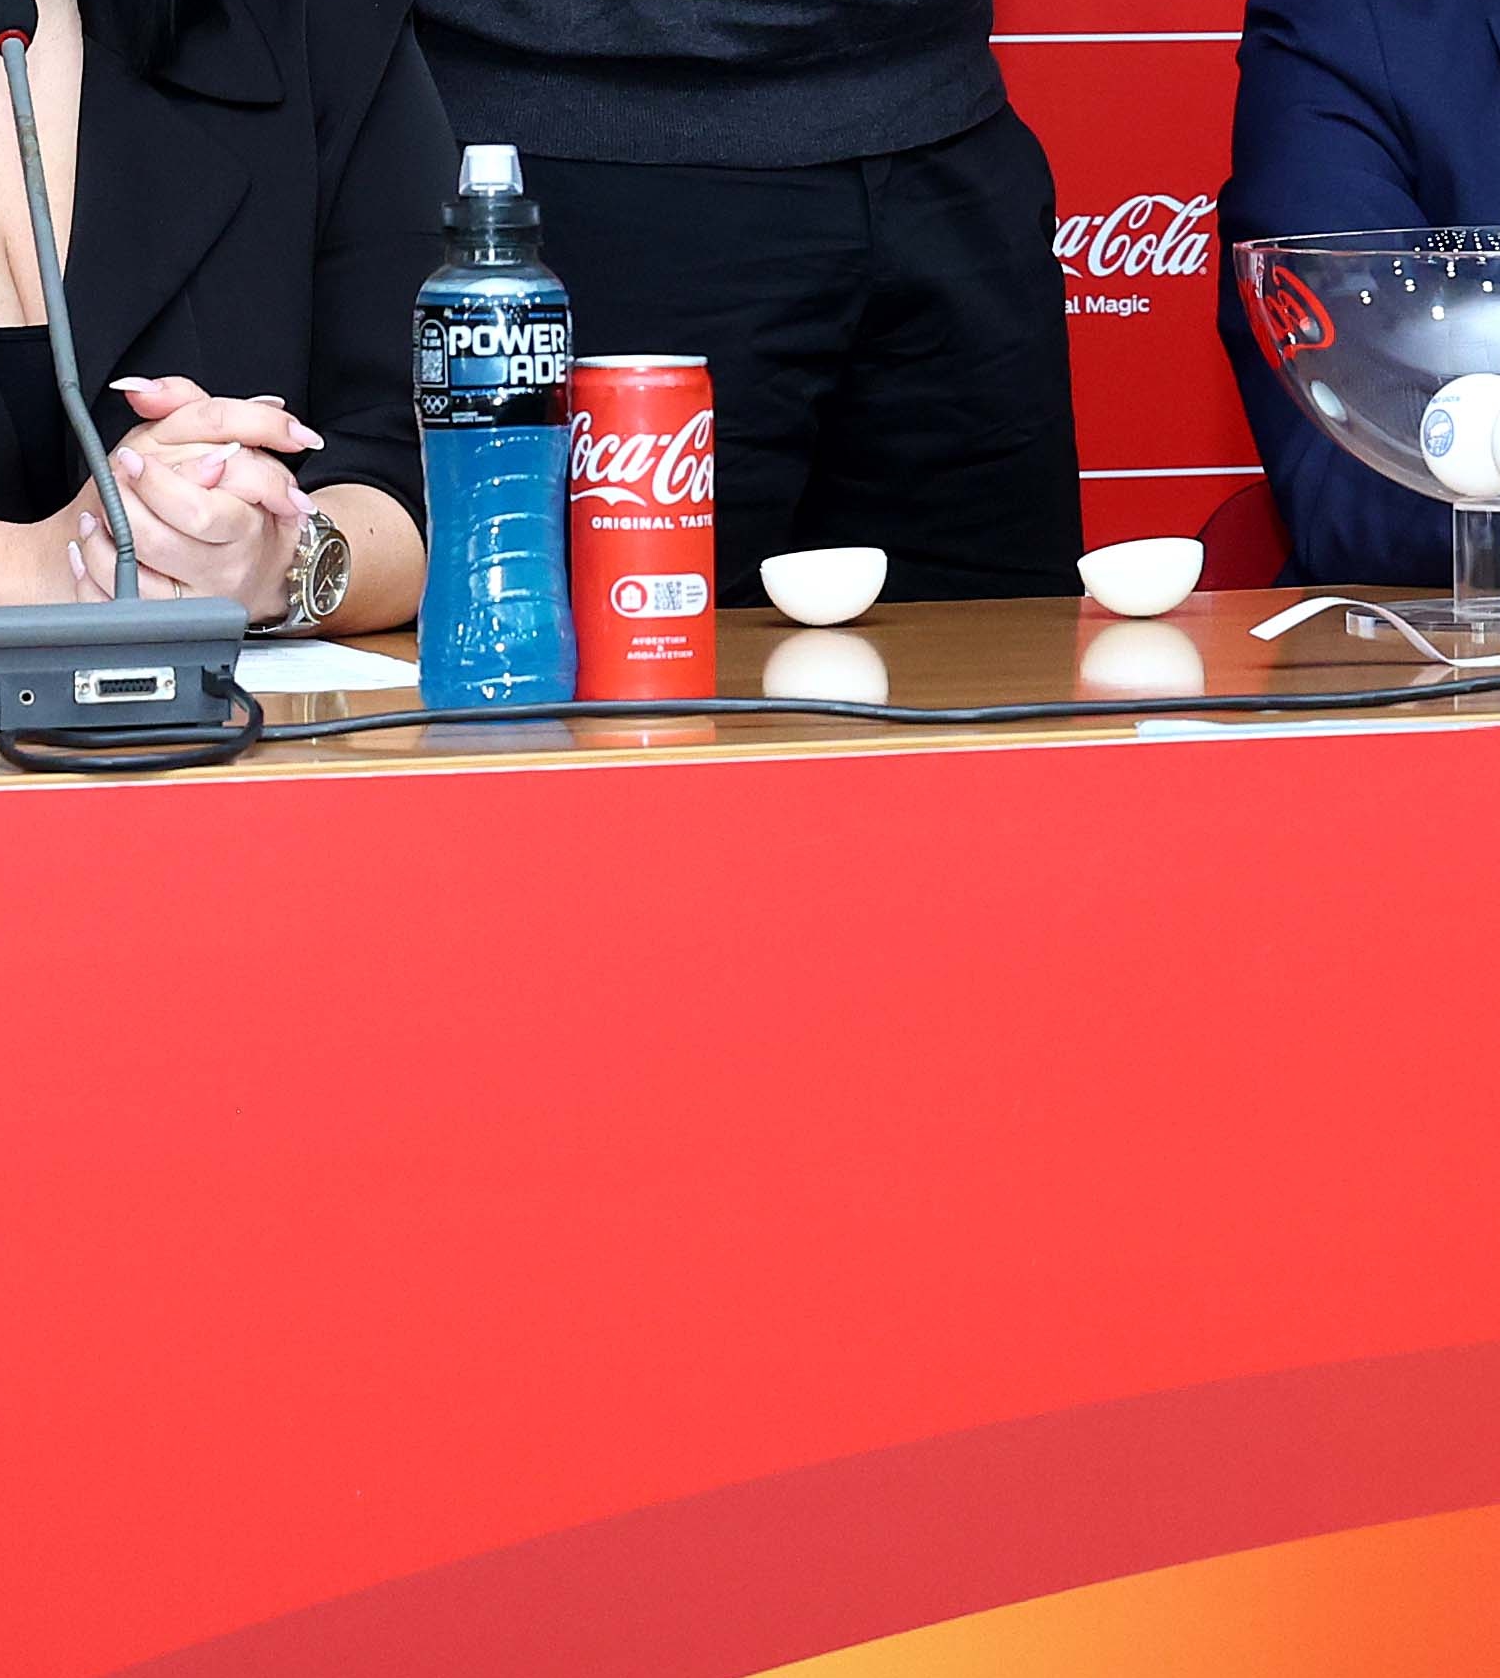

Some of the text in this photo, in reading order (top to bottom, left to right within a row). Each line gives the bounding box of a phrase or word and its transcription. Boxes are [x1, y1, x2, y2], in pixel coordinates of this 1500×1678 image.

[1085, 294, 1151, 318] Magic
[449, 323, 566, 356] POWER
[509, 353, 566, 385] ADE
[591, 515, 675, 530] ORIGINAL
